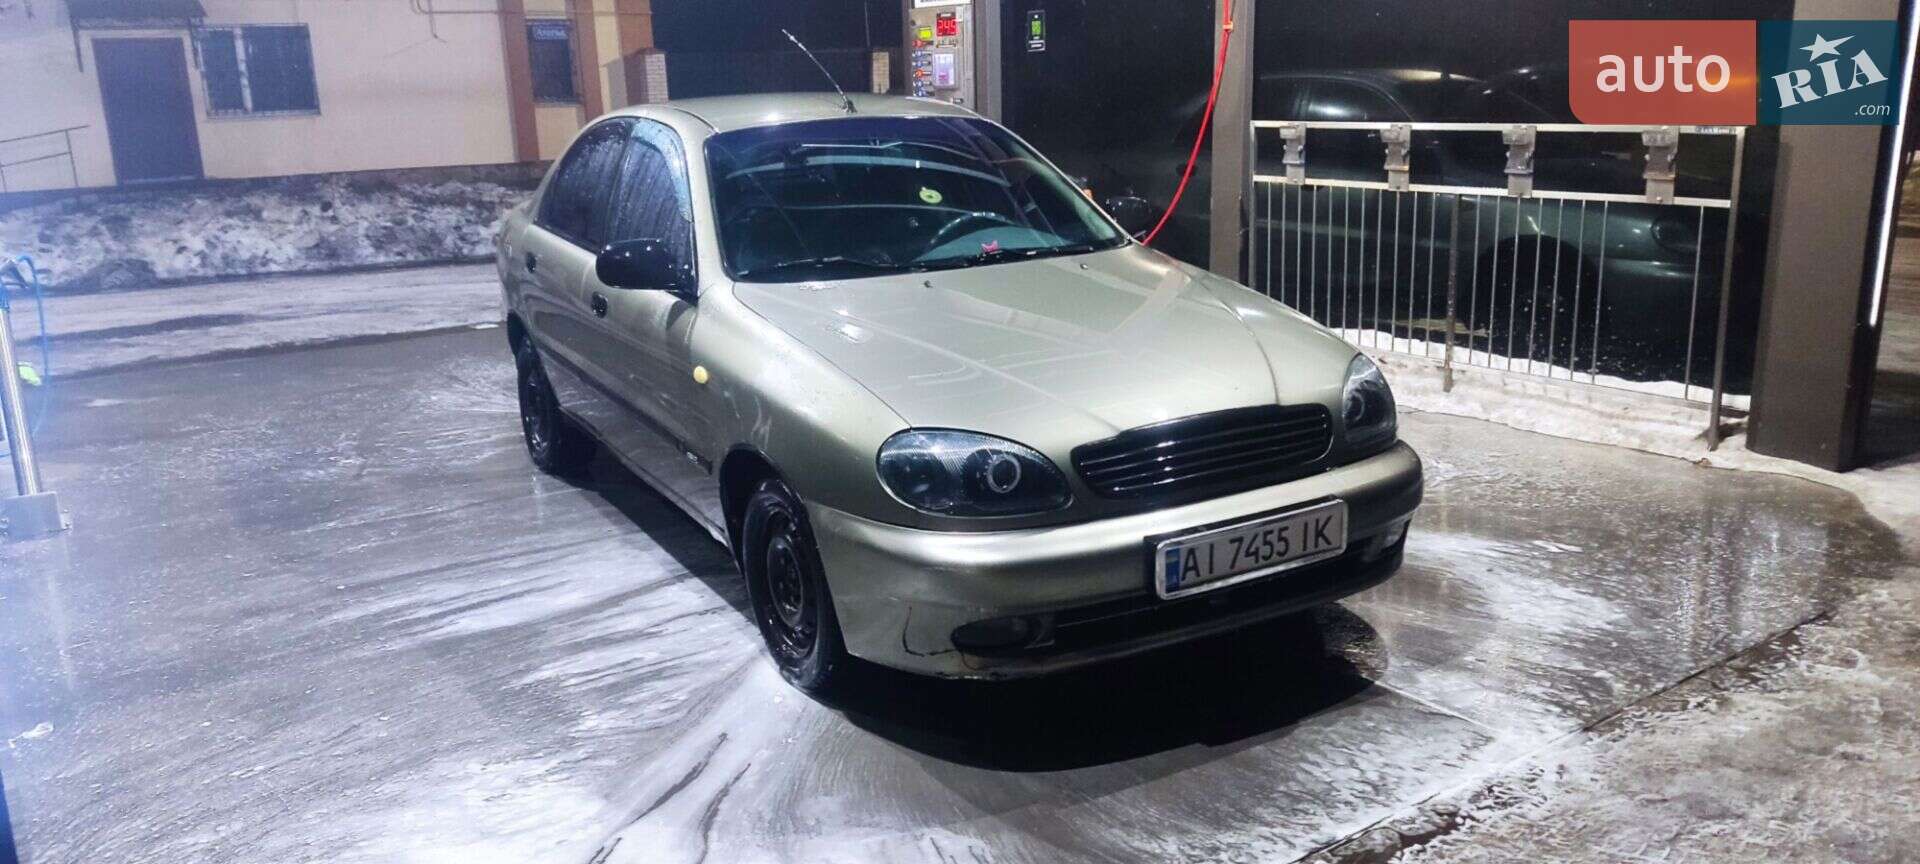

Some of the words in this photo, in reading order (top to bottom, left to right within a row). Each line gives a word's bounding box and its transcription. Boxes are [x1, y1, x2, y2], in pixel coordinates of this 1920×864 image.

[1181, 543, 1214, 582] AI
[1229, 526, 1289, 570] 7455
[1302, 515, 1333, 552] IK
